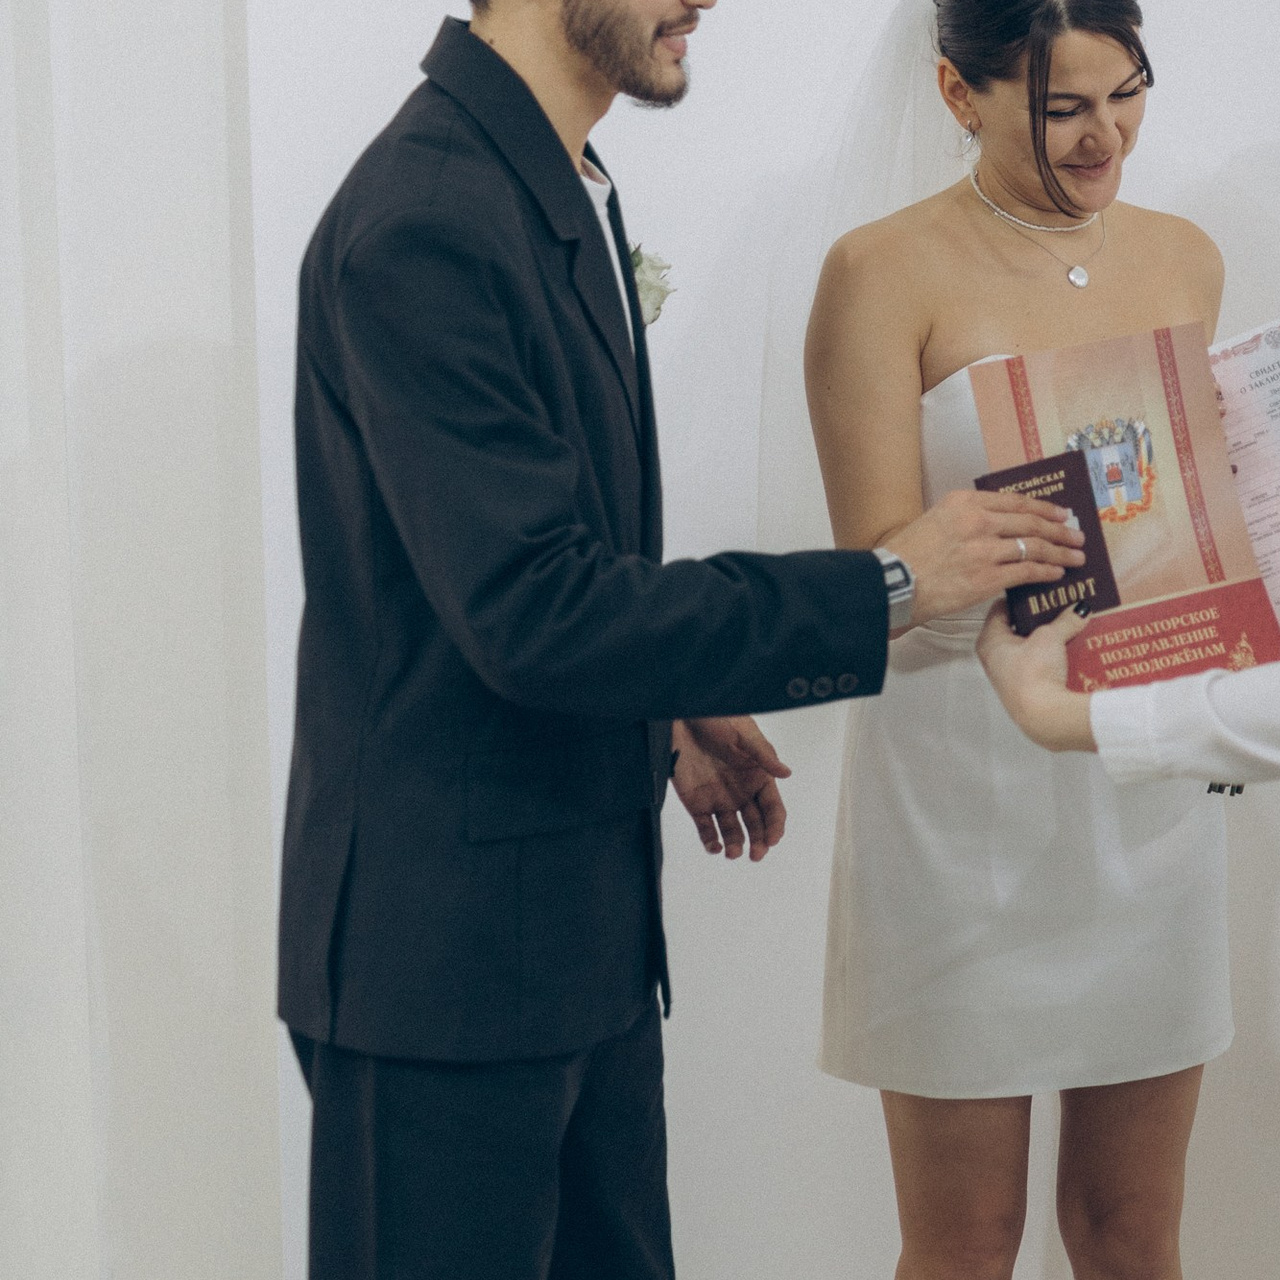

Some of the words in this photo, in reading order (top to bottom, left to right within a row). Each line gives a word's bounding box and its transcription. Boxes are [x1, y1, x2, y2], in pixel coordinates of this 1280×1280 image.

[1239, 386, 1247, 395] О
[999, 470, 1066, 495] РОССИЙСКАЯ
[1027, 577, 1097, 616] ПАСПОРТ
[1085, 606, 1221, 651] ГУБЕРНАТОРСКОЕ
[1100, 625, 1220, 666] ПОЗДРАВЛЕНИЕ
[1105, 642, 1227, 682] МОЛОДОЖЁНАМ
